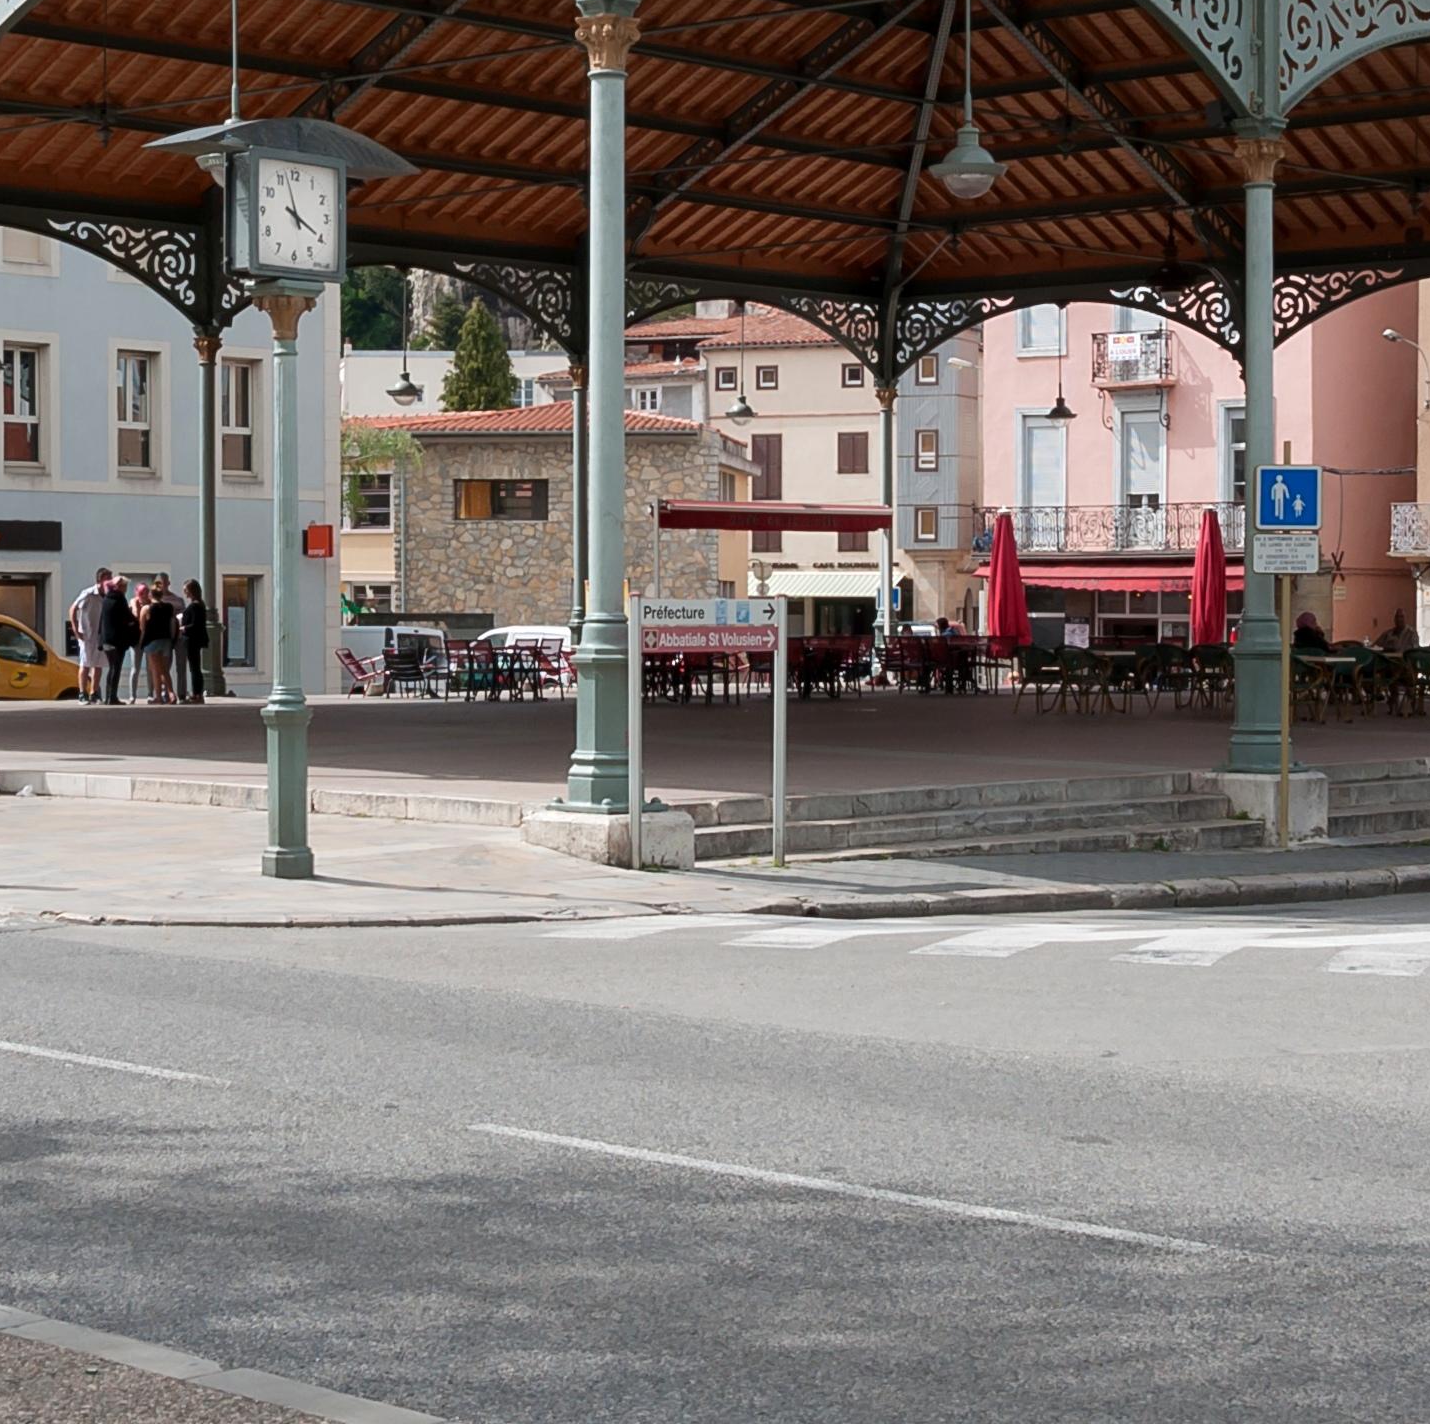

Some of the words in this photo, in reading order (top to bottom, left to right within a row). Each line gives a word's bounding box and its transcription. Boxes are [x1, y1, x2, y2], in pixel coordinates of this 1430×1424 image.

[277, 173, 284, 186] 11
[290, 170, 300, 182] 12
[265, 186, 275, 199] 10
[319, 194, 325, 206] 2
[260, 205, 266, 217] 9
[323, 213, 330, 225] 3
[265, 225, 271, 237] 8
[274, 241, 282, 256] 7
[307, 246, 314, 258] 5
[291, 249, 298, 262] 6
[643, 605, 705, 620] Préfecture
[659, 632, 707, 647] Abbatiale
[708, 632, 720, 647] St
[721, 631, 762, 646] Volusien
